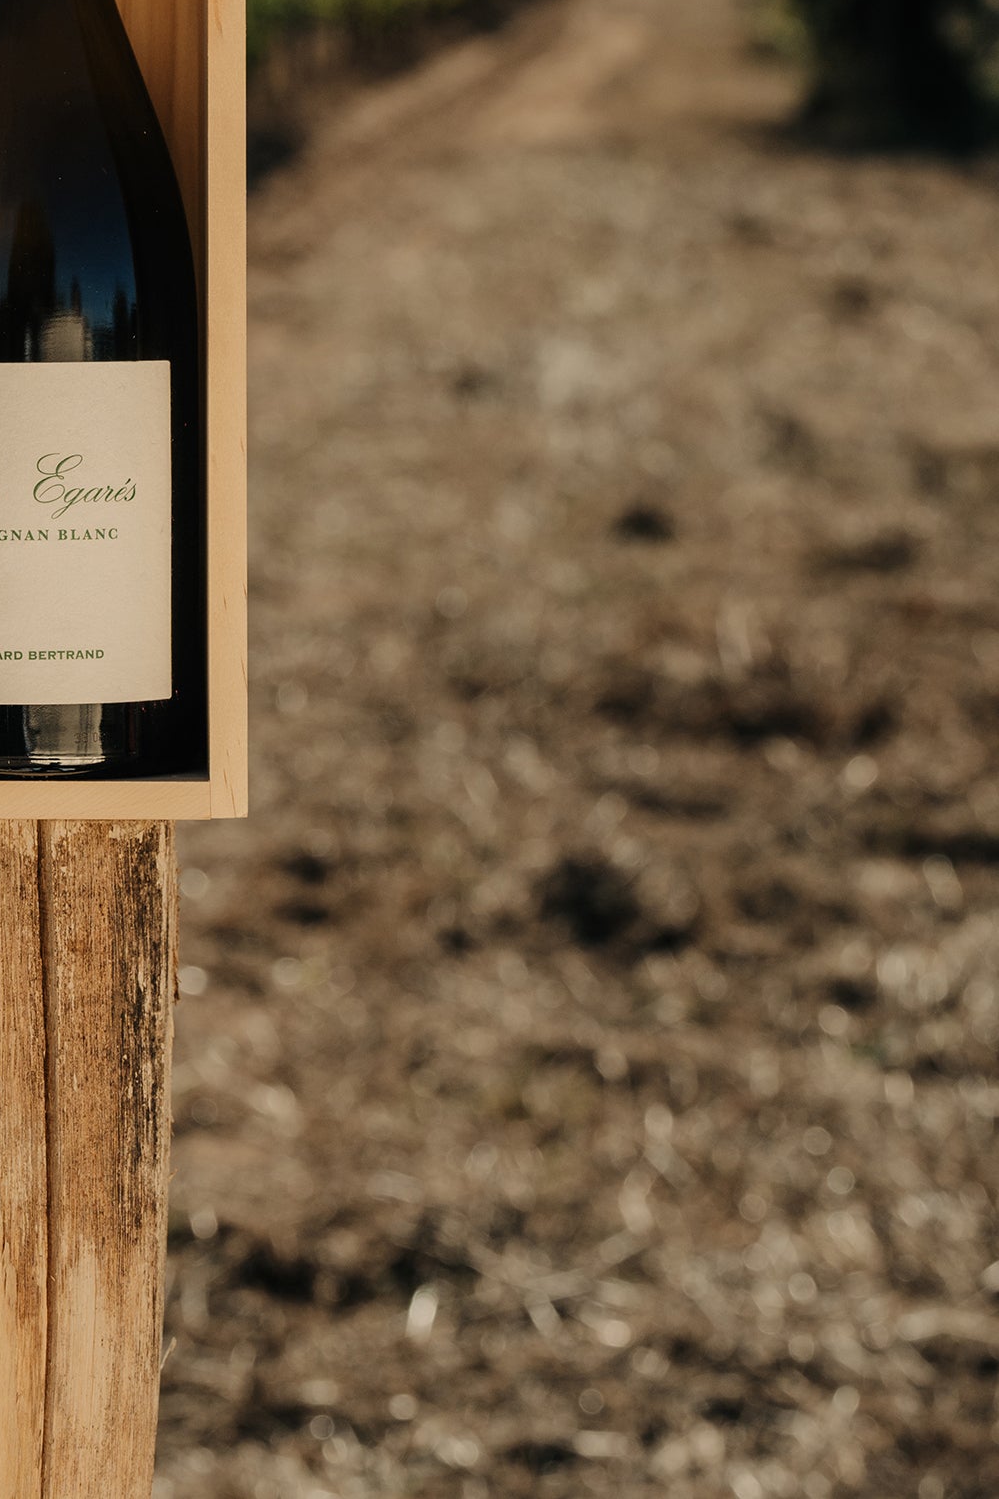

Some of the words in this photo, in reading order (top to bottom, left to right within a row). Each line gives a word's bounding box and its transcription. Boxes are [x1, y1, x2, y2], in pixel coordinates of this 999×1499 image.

[33, 453, 137, 519] Egarés
[58, 528, 119, 541] BLANC
[28, 649, 105, 661] BERTRAND
